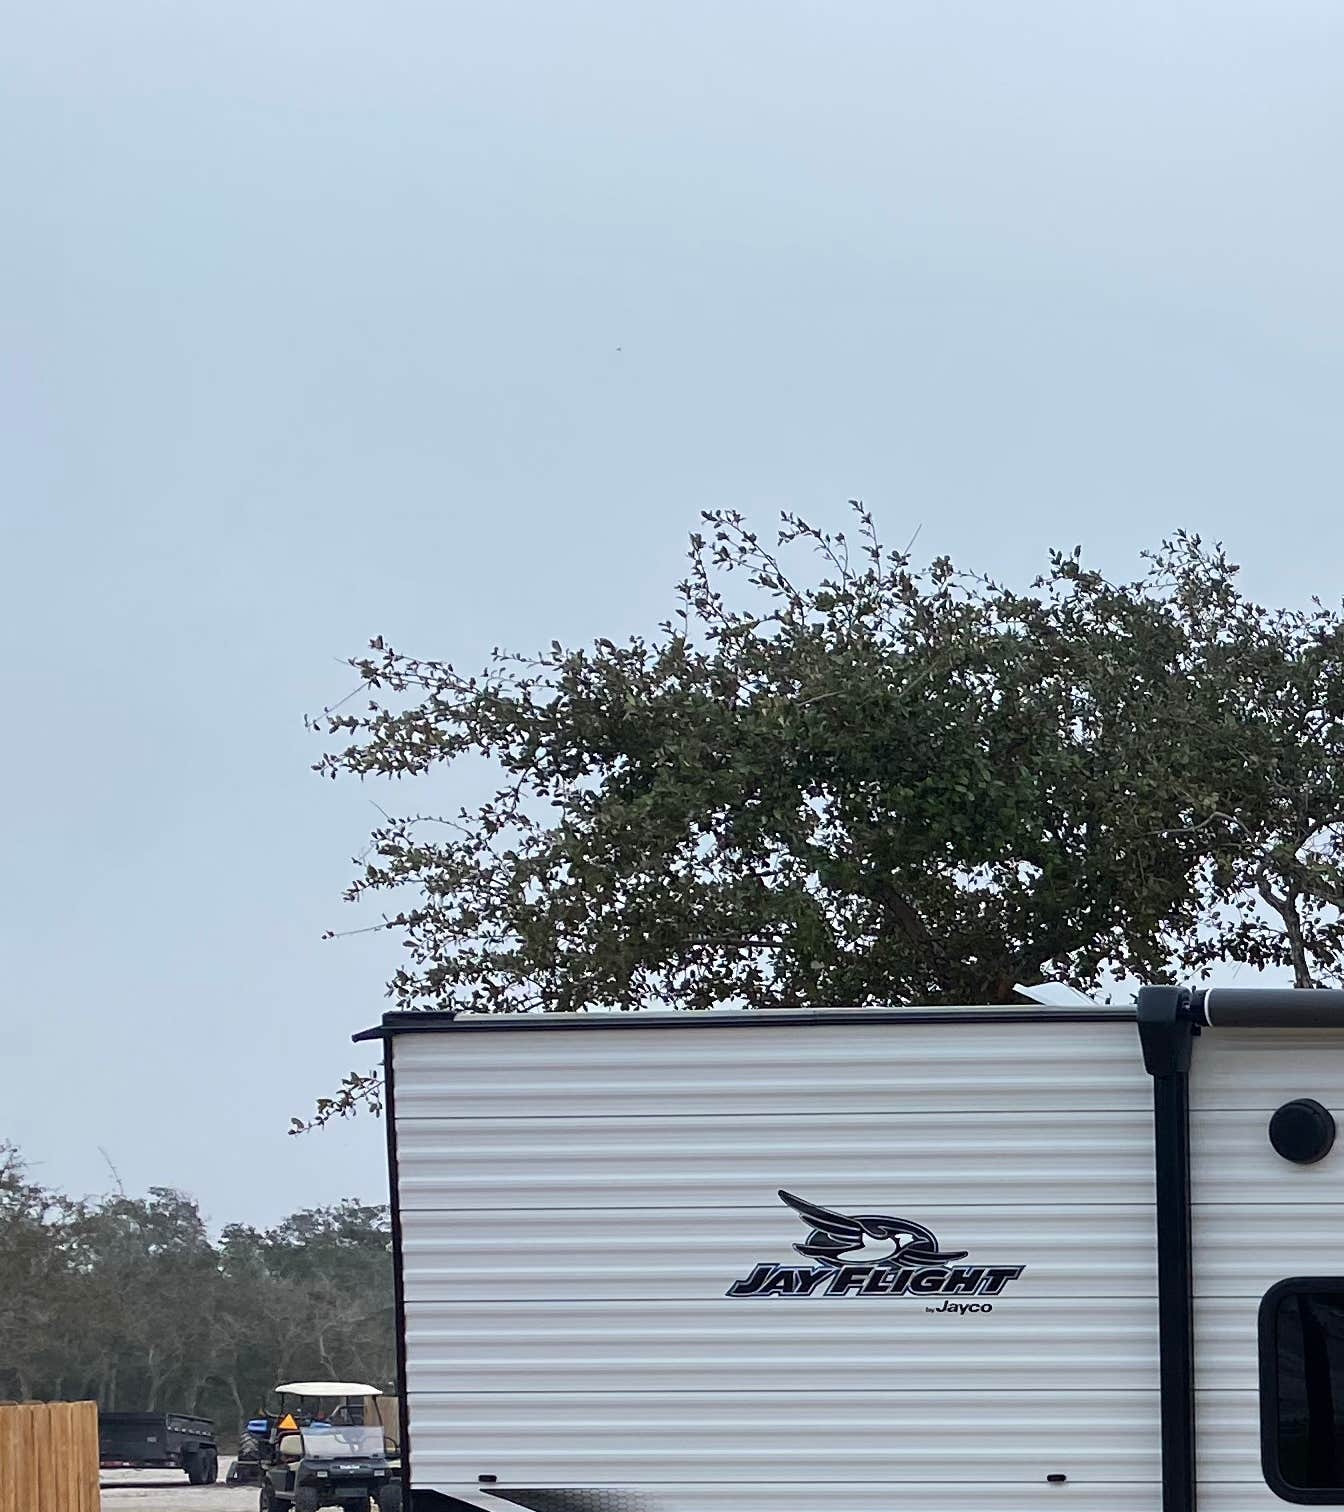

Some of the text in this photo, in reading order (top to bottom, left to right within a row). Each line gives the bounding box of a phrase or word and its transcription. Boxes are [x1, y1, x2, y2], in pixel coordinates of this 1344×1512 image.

[725, 1263, 1026, 1297] JAY FLIGHT
[935, 1299, 993, 1316] Jayco
